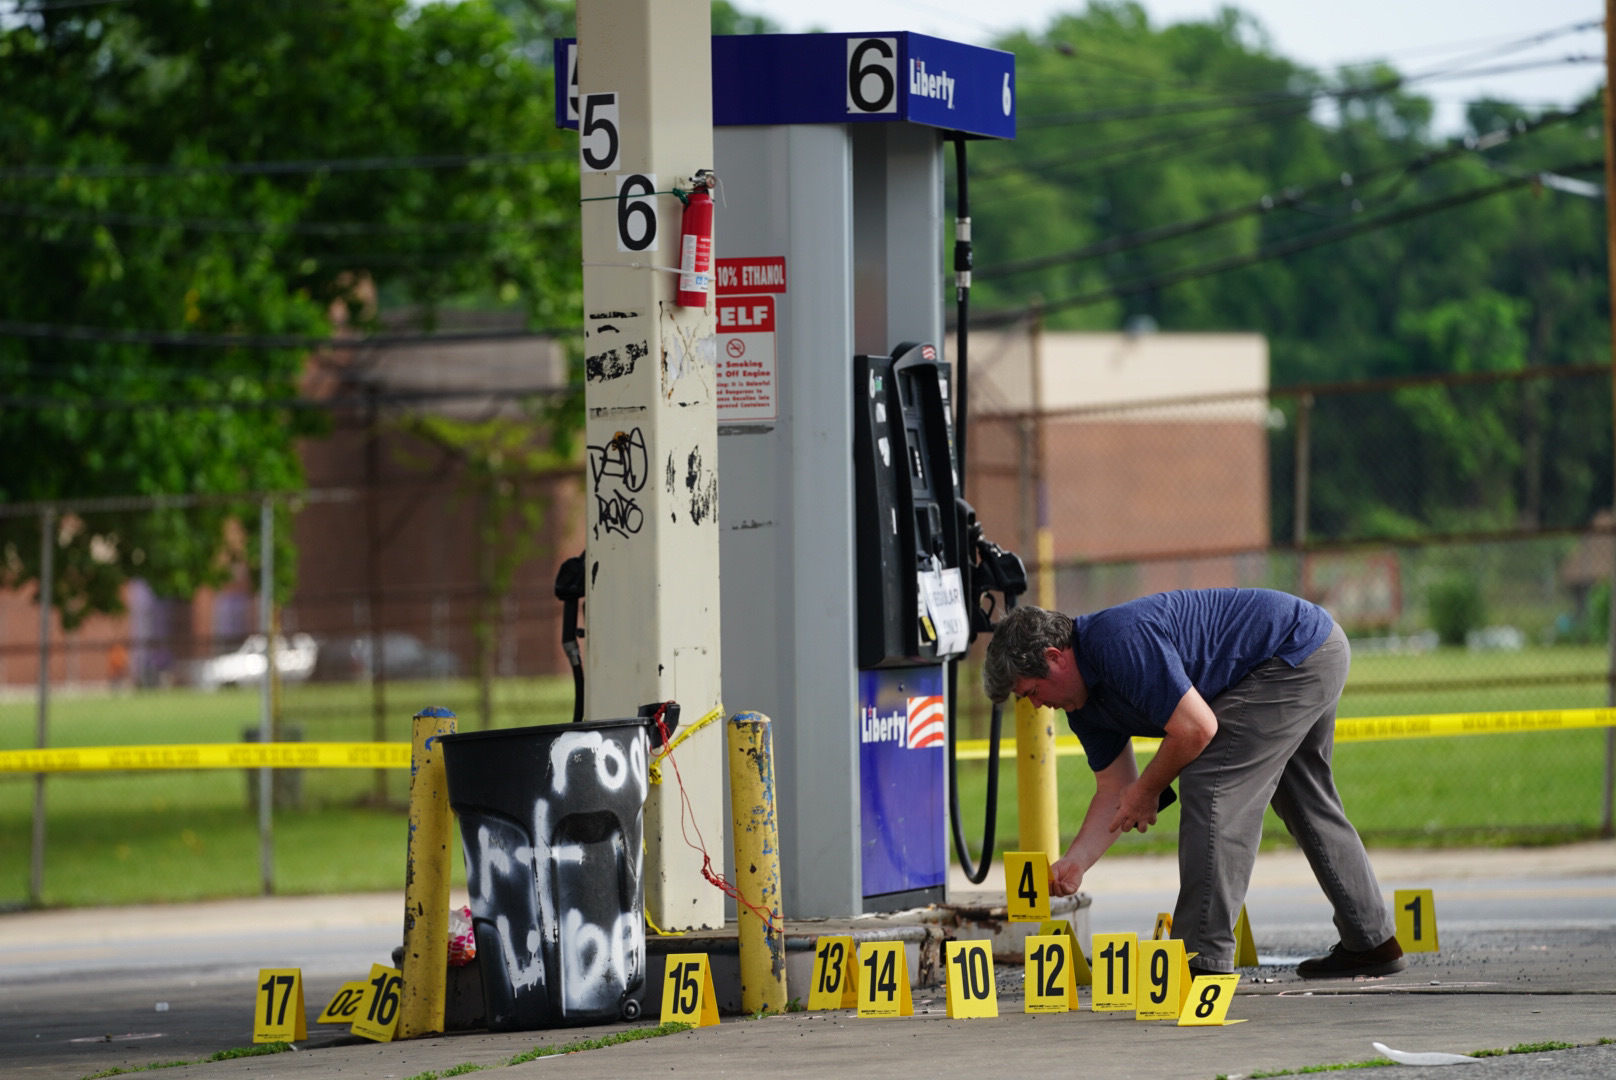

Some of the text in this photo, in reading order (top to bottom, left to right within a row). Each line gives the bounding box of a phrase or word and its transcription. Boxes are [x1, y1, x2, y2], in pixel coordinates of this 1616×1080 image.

[848, 39, 895, 113] 6
[909, 57, 955, 109] Liberty
[1002, 73, 1012, 116] 6
[582, 94, 619, 170] 5
[617, 174, 657, 251] 6
[717, 266, 738, 287] 10%
[742, 265, 785, 286] ETHANOL
[716, 305, 768, 327] ELF
[725, 360, 763, 369] Smoking
[742, 369, 771, 378] Engine
[861, 705, 906, 748] Liberty
[1018, 861, 1038, 908] 4
[1404, 896, 1421, 941] 1
[668, 962, 700, 1015] 15
[818, 942, 844, 993] 13
[863, 950, 897, 1002] 14
[952, 946, 990, 1000] 10
[1029, 943, 1065, 997] 12
[1100, 941, 1130, 995] 11
[1150, 948, 1169, 1004] 9
[261, 975, 295, 1026] 17
[367, 972, 401, 1026] 16
[1194, 984, 1221, 1019] 8
